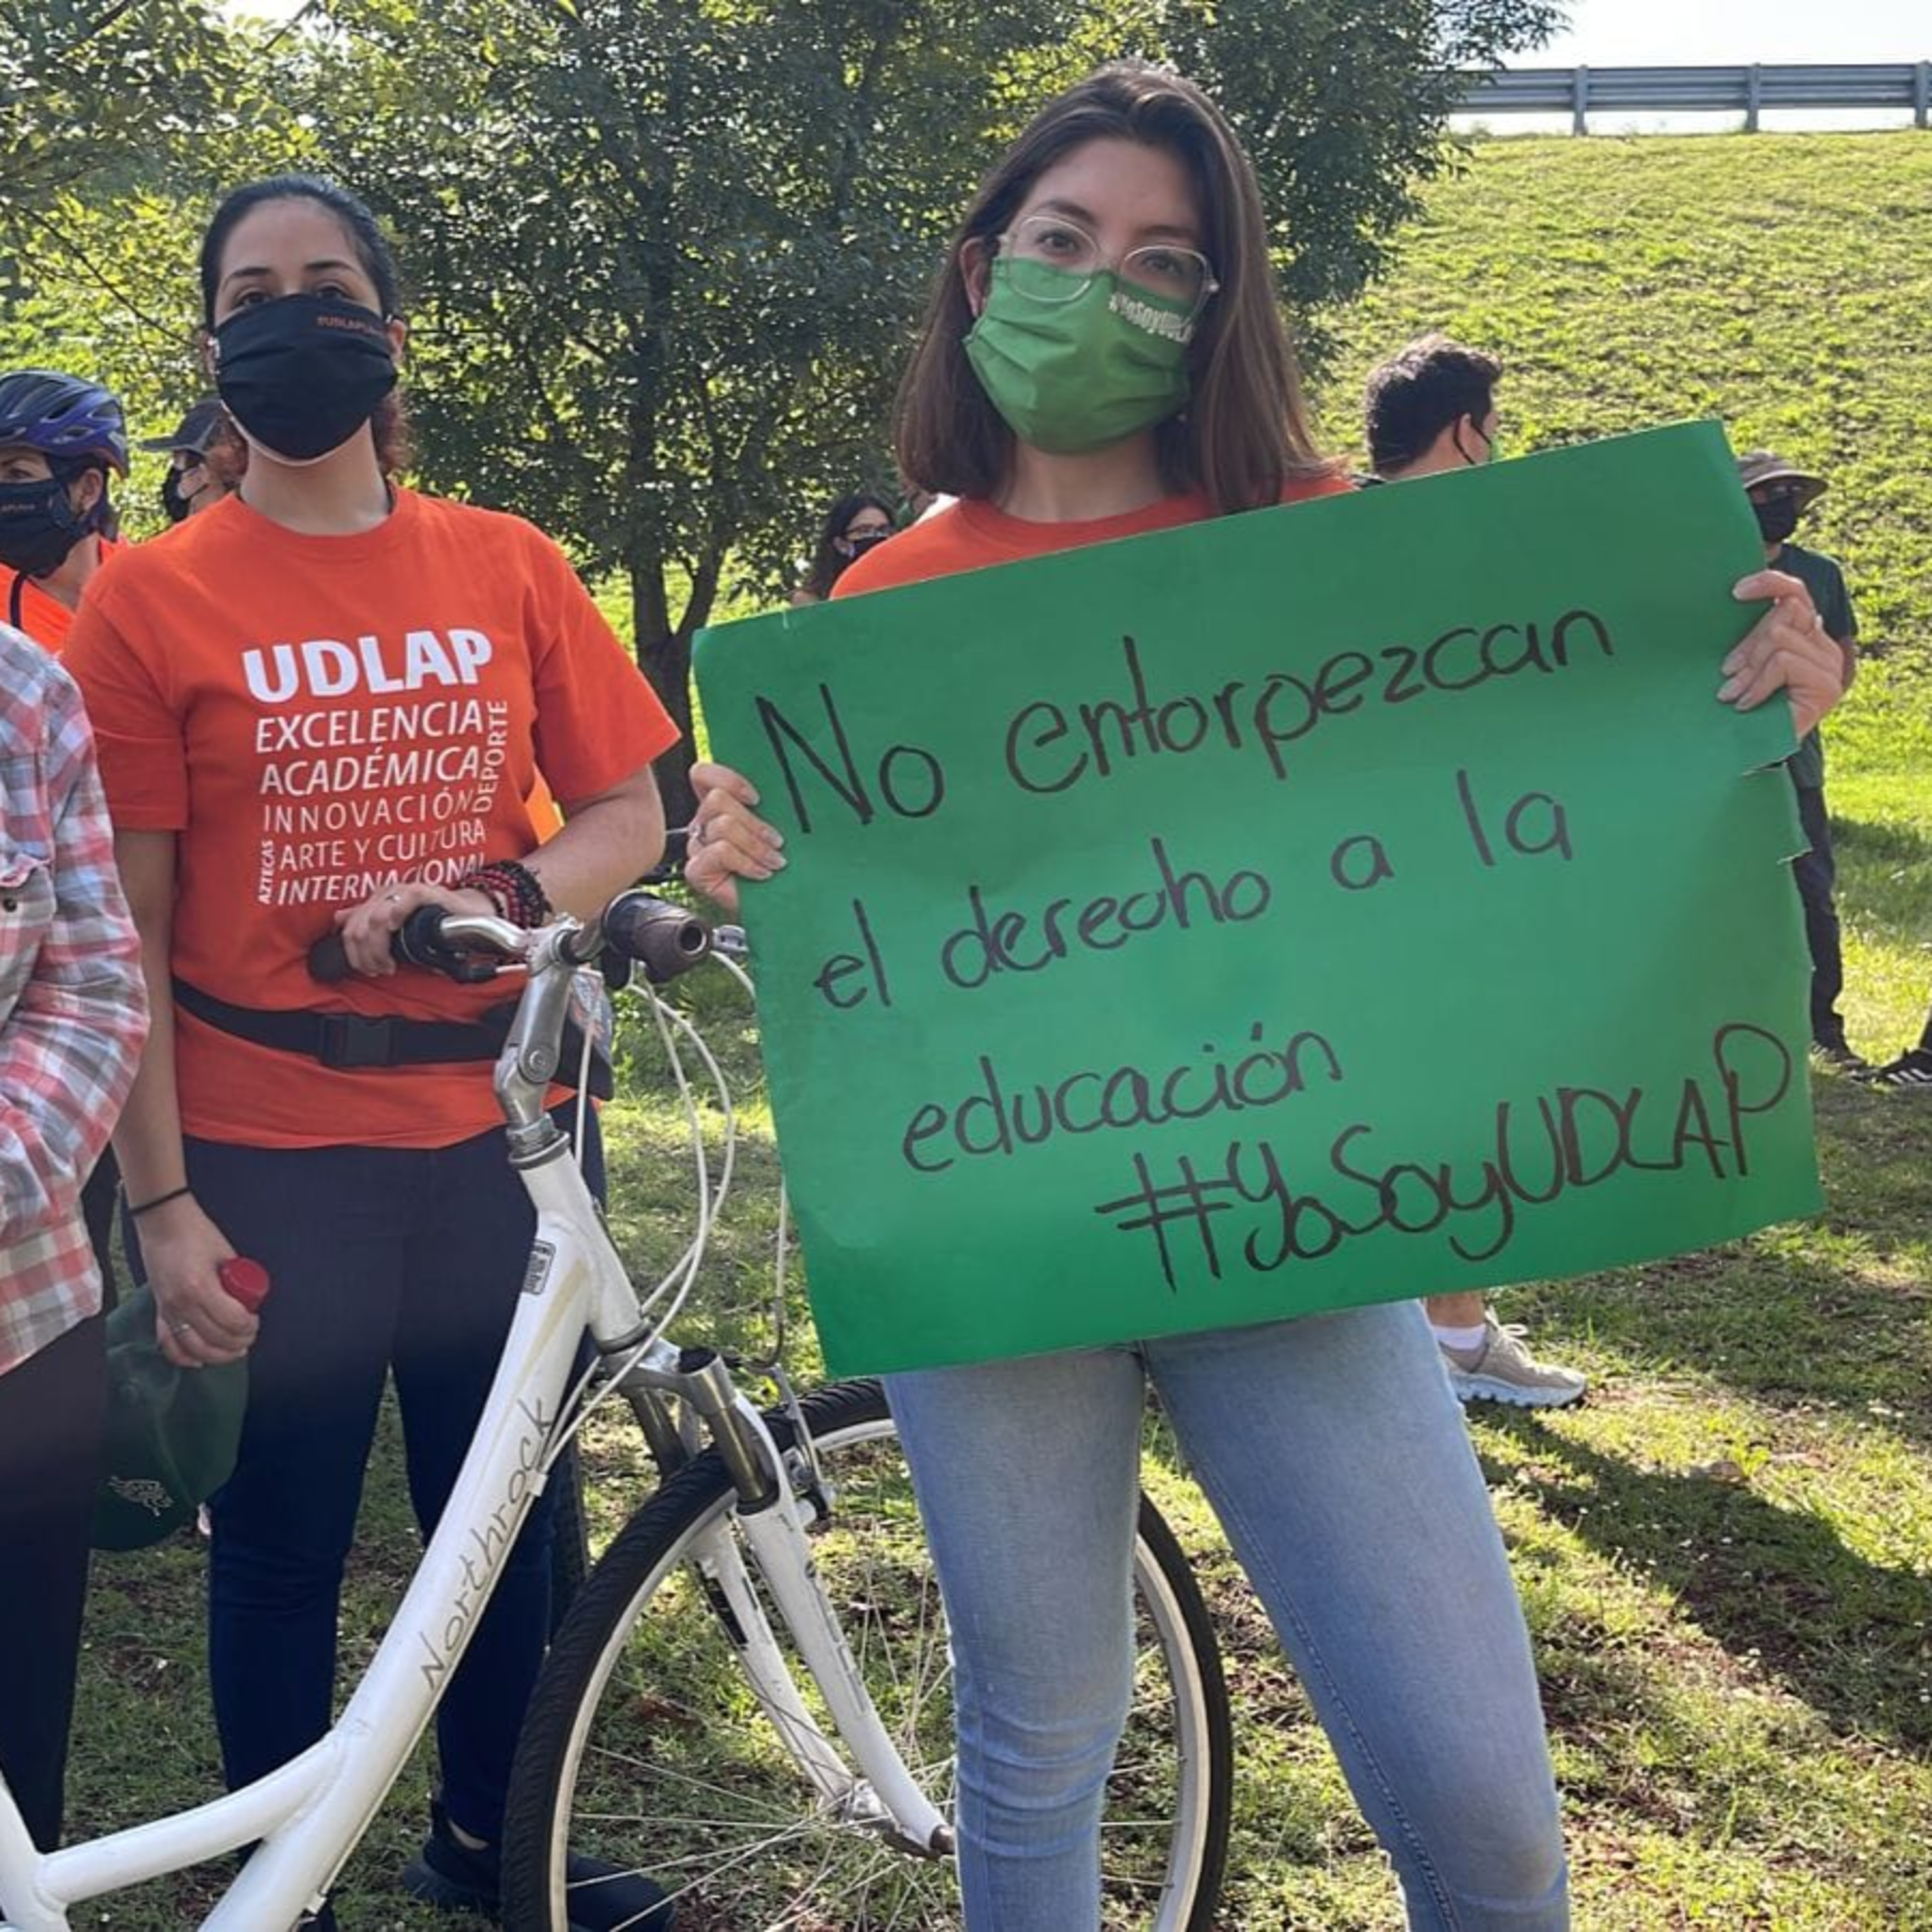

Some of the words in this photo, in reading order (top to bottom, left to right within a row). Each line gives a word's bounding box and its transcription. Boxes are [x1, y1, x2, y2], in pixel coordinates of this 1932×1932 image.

[242, 629, 493, 703] UDLAP
[256, 699, 484, 753] EXCELENCIA
[472, 700, 508, 813] DEPORTE
[753, 683, 945, 835] No
[1005, 609, 1615, 794] entorpezcan
[260, 745, 479, 797] ACADÉMICA
[263, 785, 474, 834] INNOVACIÓN
[280, 837, 346, 872] ARTE
[354, 838, 371, 864] Y
[377, 818, 486, 861] CULTURA
[258, 838, 274, 905] AZTECAS
[813, 899, 892, 1009] el
[941, 837, 1271, 990] derecho
[1330, 835, 1394, 892] a
[1457, 770, 1573, 867] la
[902, 1021, 1343, 1173] educación
[419, 1398, 554, 1690] Northrock
